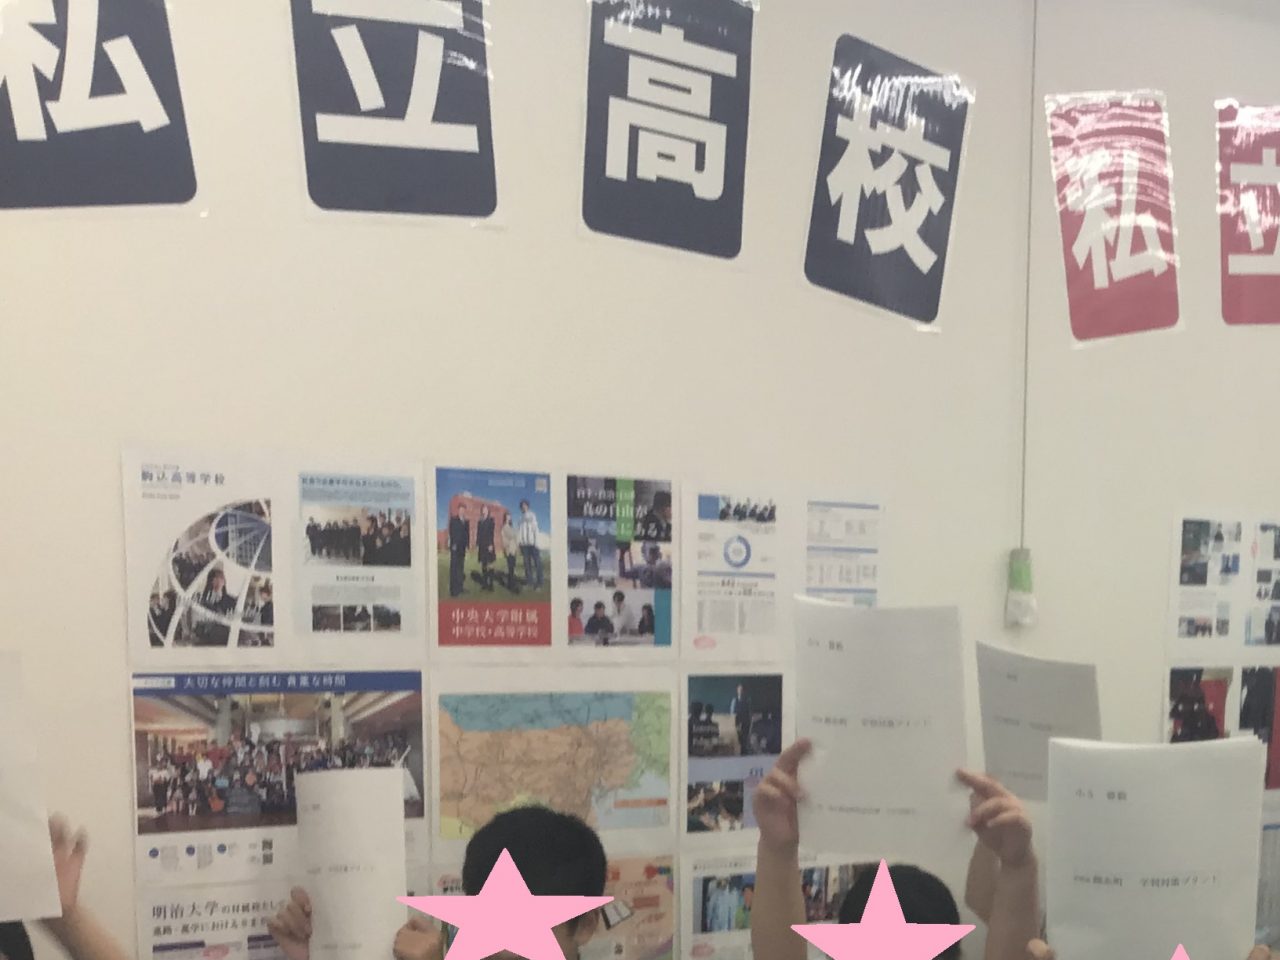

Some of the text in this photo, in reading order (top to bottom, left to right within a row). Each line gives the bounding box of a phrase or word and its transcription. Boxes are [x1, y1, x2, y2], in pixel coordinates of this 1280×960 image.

[452, 607, 539, 624] 中央大学附属
[452, 624, 539, 639] 中学校・高等学校
